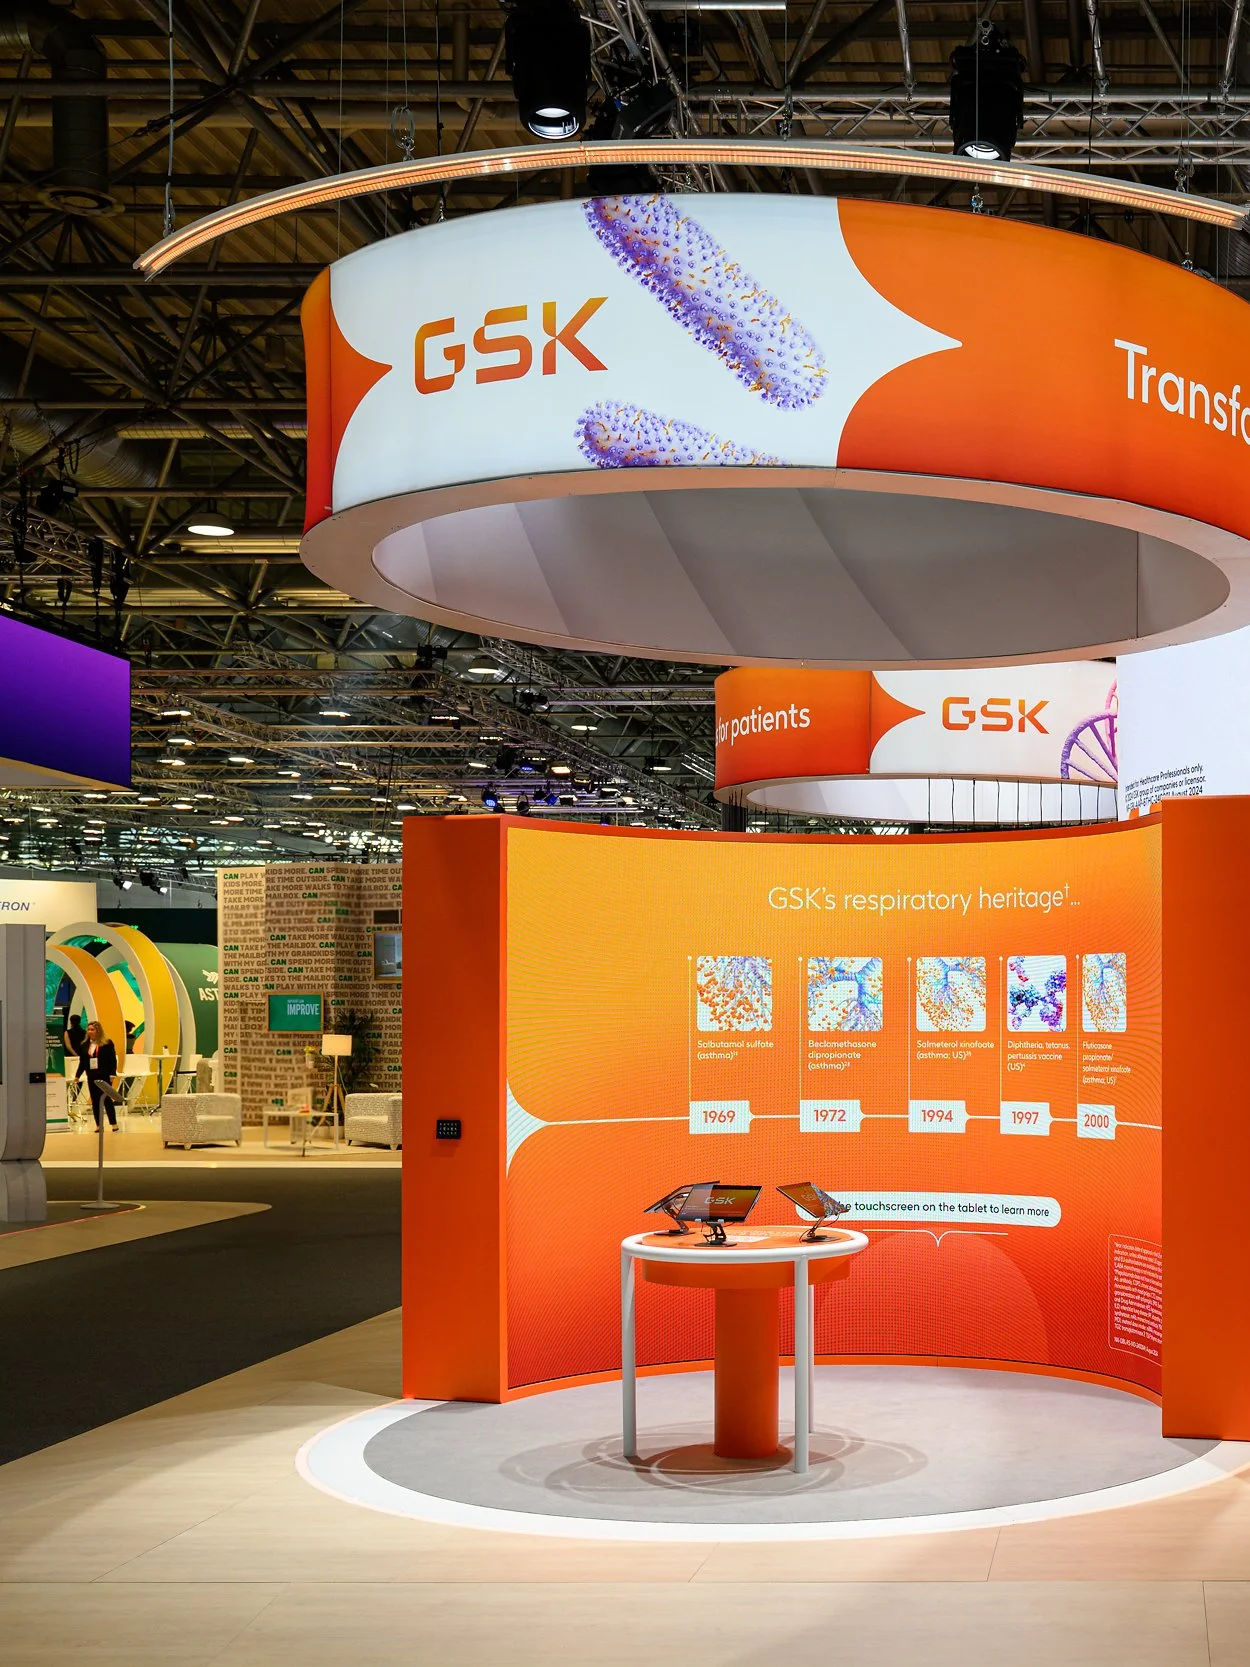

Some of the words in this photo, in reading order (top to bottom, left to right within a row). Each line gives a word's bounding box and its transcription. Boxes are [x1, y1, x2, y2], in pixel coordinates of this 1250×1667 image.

[415, 297, 608, 394] GSK
[942, 696, 1050, 735] GSK
[718, 716, 729, 743] for
[731, 703, 811, 747] patients
[1160, 765, 1190, 780] Professionals
[1189, 785, 1203, 796] 2024
[0, 901, 30, 911] RON
[844, 889, 972, 916] respiratory
[287, 1003, 320, 1016] IMPROVE
[697, 1039, 744, 1048] Salbutamol
[746, 1039, 774, 1048] sulfate
[808, 1039, 877, 1048] Beclomethasone
[916, 1040, 958, 1049] Salmeterol
[960, 1040, 995, 1049] xinafoate
[1007, 1040, 1044, 1050] Diphtheria,
[1045, 1041, 1070, 1050] tetanus,
[1082, 1042, 1112, 1050] Fluticasone
[808, 1050, 861, 1060] dipropionate
[1007, 1052, 1037, 1061] pertussis
[1038, 1053, 1062, 1061] vaccine
[1082, 1065, 1110, 1073] salmeterol
[702, 1110, 736, 1123] 1969
[813, 1109, 847, 1122] 1972
[921, 1109, 953, 1122] 1994
[1012, 1111, 1039, 1124] 1997
[1084, 1113, 1109, 1128] 2000
[704, 1196, 736, 1205] GSK
[854, 1201, 920, 1211] touchscreen
[922, 1203, 936, 1211] on
[938, 1202, 956, 1212] the
[957, 1203, 987, 1213] tablet
[989, 1204, 1000, 1213] to
[1001, 1205, 1025, 1215] learn
[1027, 1208, 1050, 1217] more
